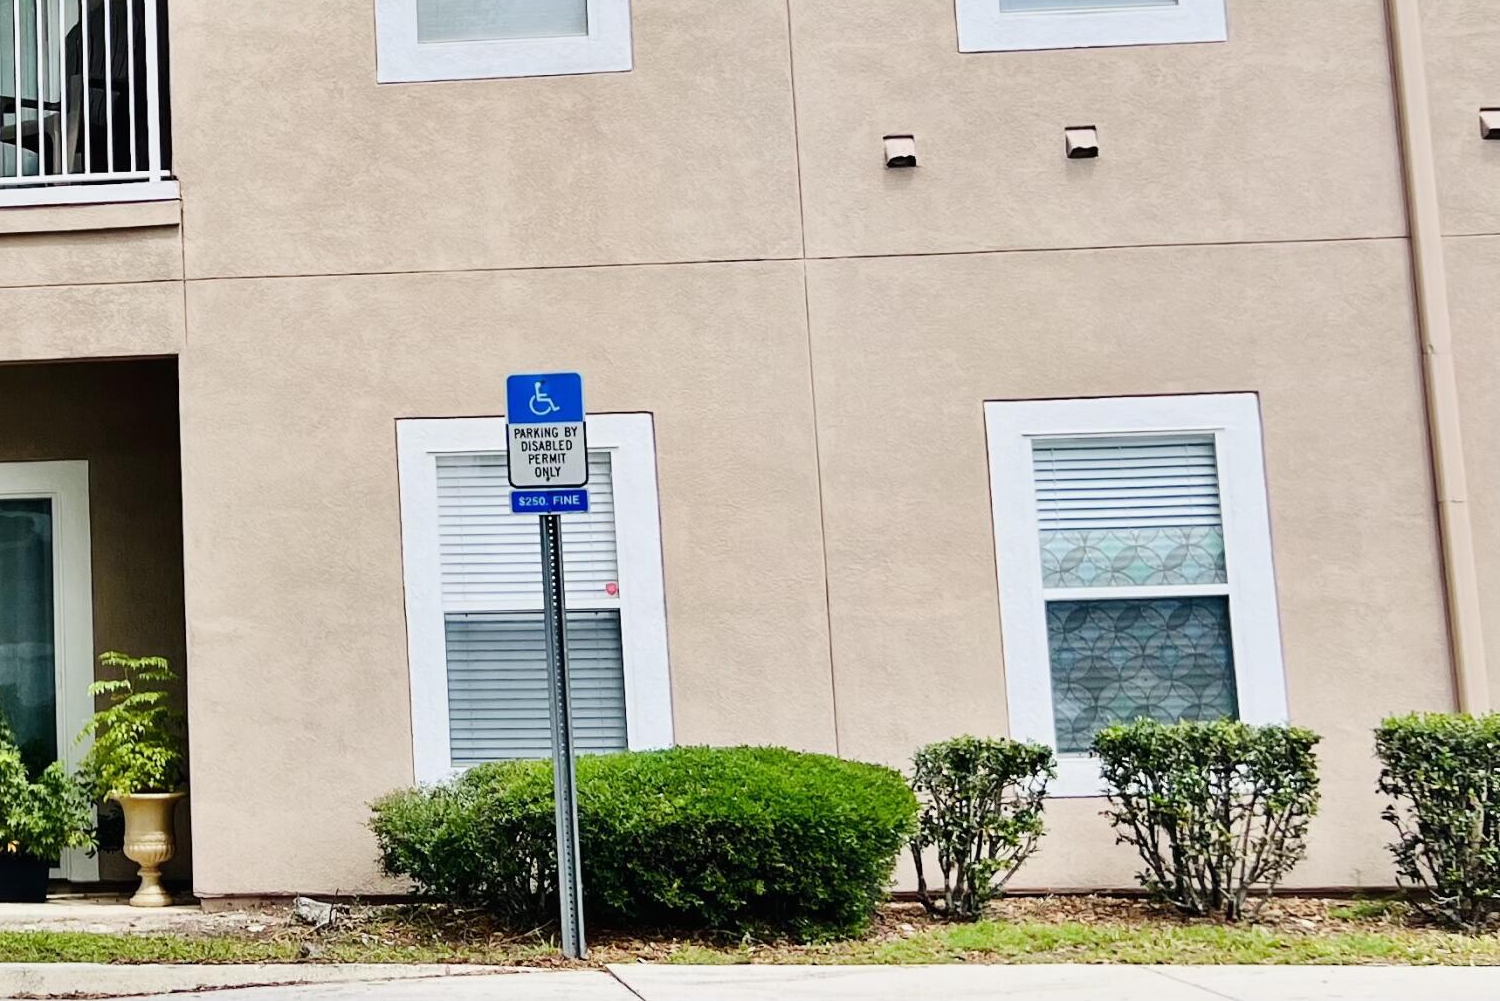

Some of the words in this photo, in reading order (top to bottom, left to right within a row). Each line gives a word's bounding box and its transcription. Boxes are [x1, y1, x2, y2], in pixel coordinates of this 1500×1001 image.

[514, 427, 559, 439] PARKING
[564, 426, 577, 438] BY
[521, 440, 572, 452] DISABLED
[528, 453, 566, 465] PERMIT
[534, 466, 561, 478] ONLY
[553, 495, 580, 505] FINE
